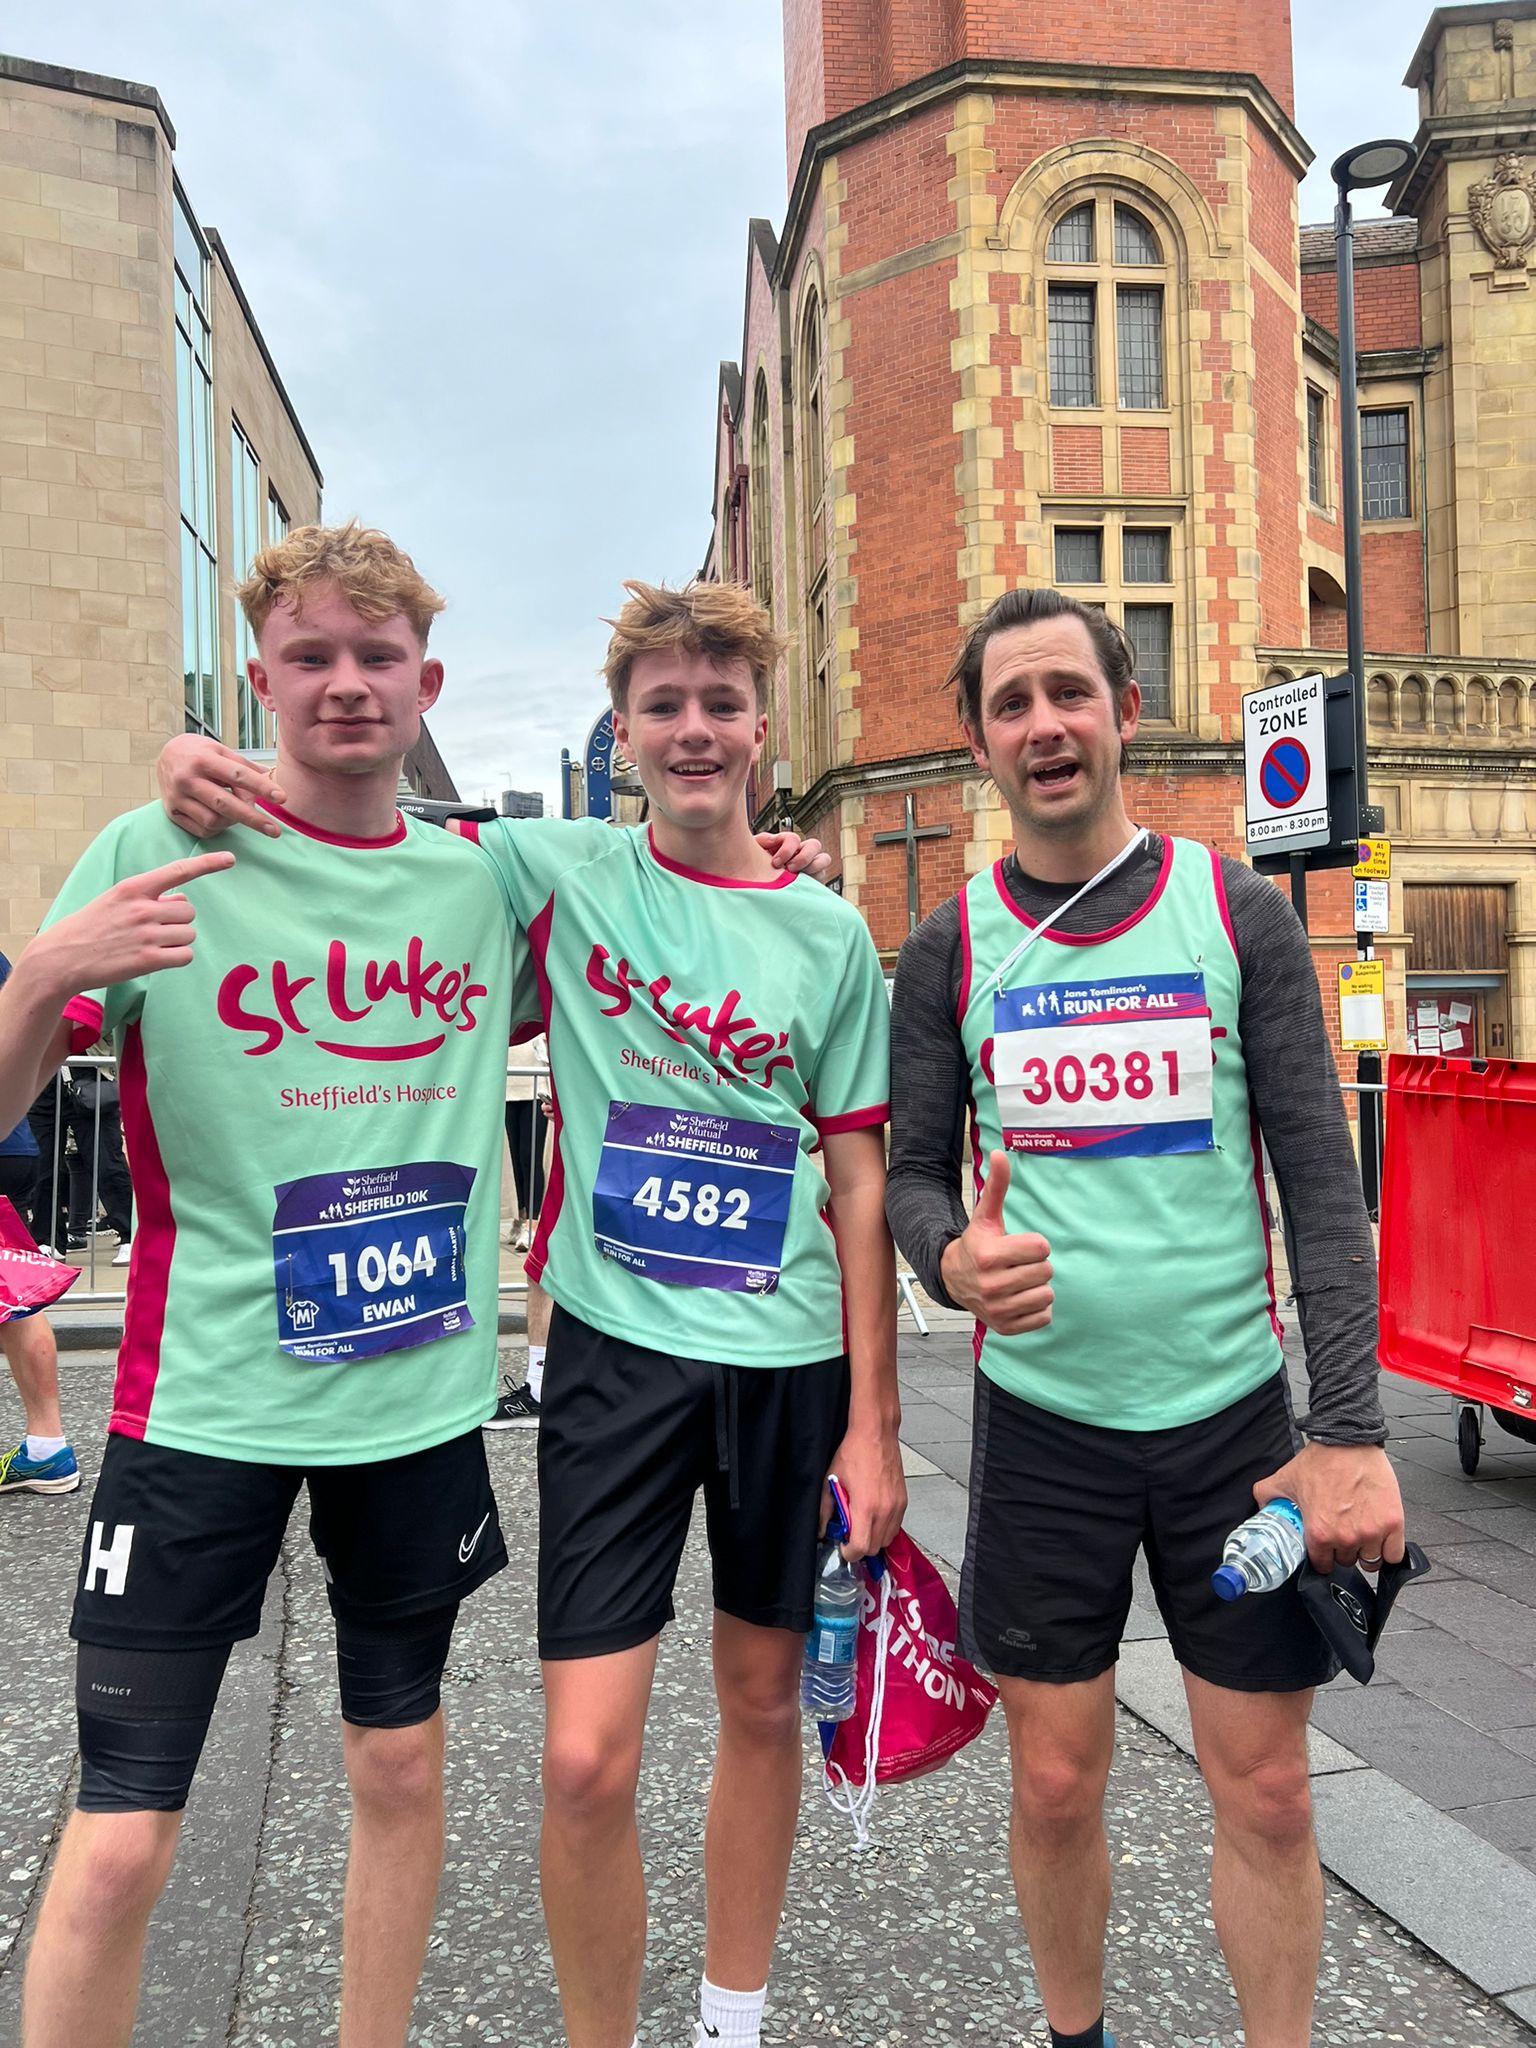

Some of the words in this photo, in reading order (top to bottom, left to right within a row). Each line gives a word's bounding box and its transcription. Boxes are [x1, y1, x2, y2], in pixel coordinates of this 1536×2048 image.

[1249, 683, 1317, 715] Controlled
[1259, 707, 1308, 736] ZONE
[594, 721, 614, 751] CH
[1250, 825, 1270, 837] 8.00
[1271, 824, 1283, 834] am
[1290, 817, 1310, 830] 8.30
[1311, 815, 1325, 828] pm
[1363, 867, 1388, 875] footway
[327, 936, 487, 1032] Luke's
[1064, 990, 1088, 998] Jane
[1089, 984, 1147, 996] Tomlinson's
[1064, 998, 1102, 1014] RUN
[1106, 995, 1141, 1012] FOR
[1146, 993, 1178, 1008] ALL
[620, 1048, 711, 1084] Sheffield's
[1022, 1051, 1179, 1105] 30381
[280, 1085, 391, 1111] Sheffield's
[397, 1083, 457, 1105] Hospice
[688, 1127, 722, 1139] Mutual
[689, 1116, 729, 1131] Sheffield
[666, 1135, 733, 1156] SHEFFIELD
[735, 1145, 759, 1160] 10K
[1012, 1139, 1033, 1147] RUN
[1034, 1139, 1053, 1147] FOR
[1055, 1139, 1072, 1147] ALL
[361, 1171, 398, 1185] Sheffield
[361, 1182, 392, 1196] Mutual
[345, 1194, 404, 1216] SHEFFIELD
[406, 1189, 428, 1204] 10K
[632, 1176, 750, 1230] 4582
[0, 1249, 56, 1268] THON
[328, 1235, 437, 1296] 1064
[618, 1252, 631, 1263] FOR
[632, 1258, 646, 1267] ALL
[296, 1308, 311, 1325] M
[362, 1295, 416, 1323] EWAN
[316, 1346, 335, 1356] FOR
[337, 1344, 354, 1354] ALL
[84, 1521, 135, 1596] H
